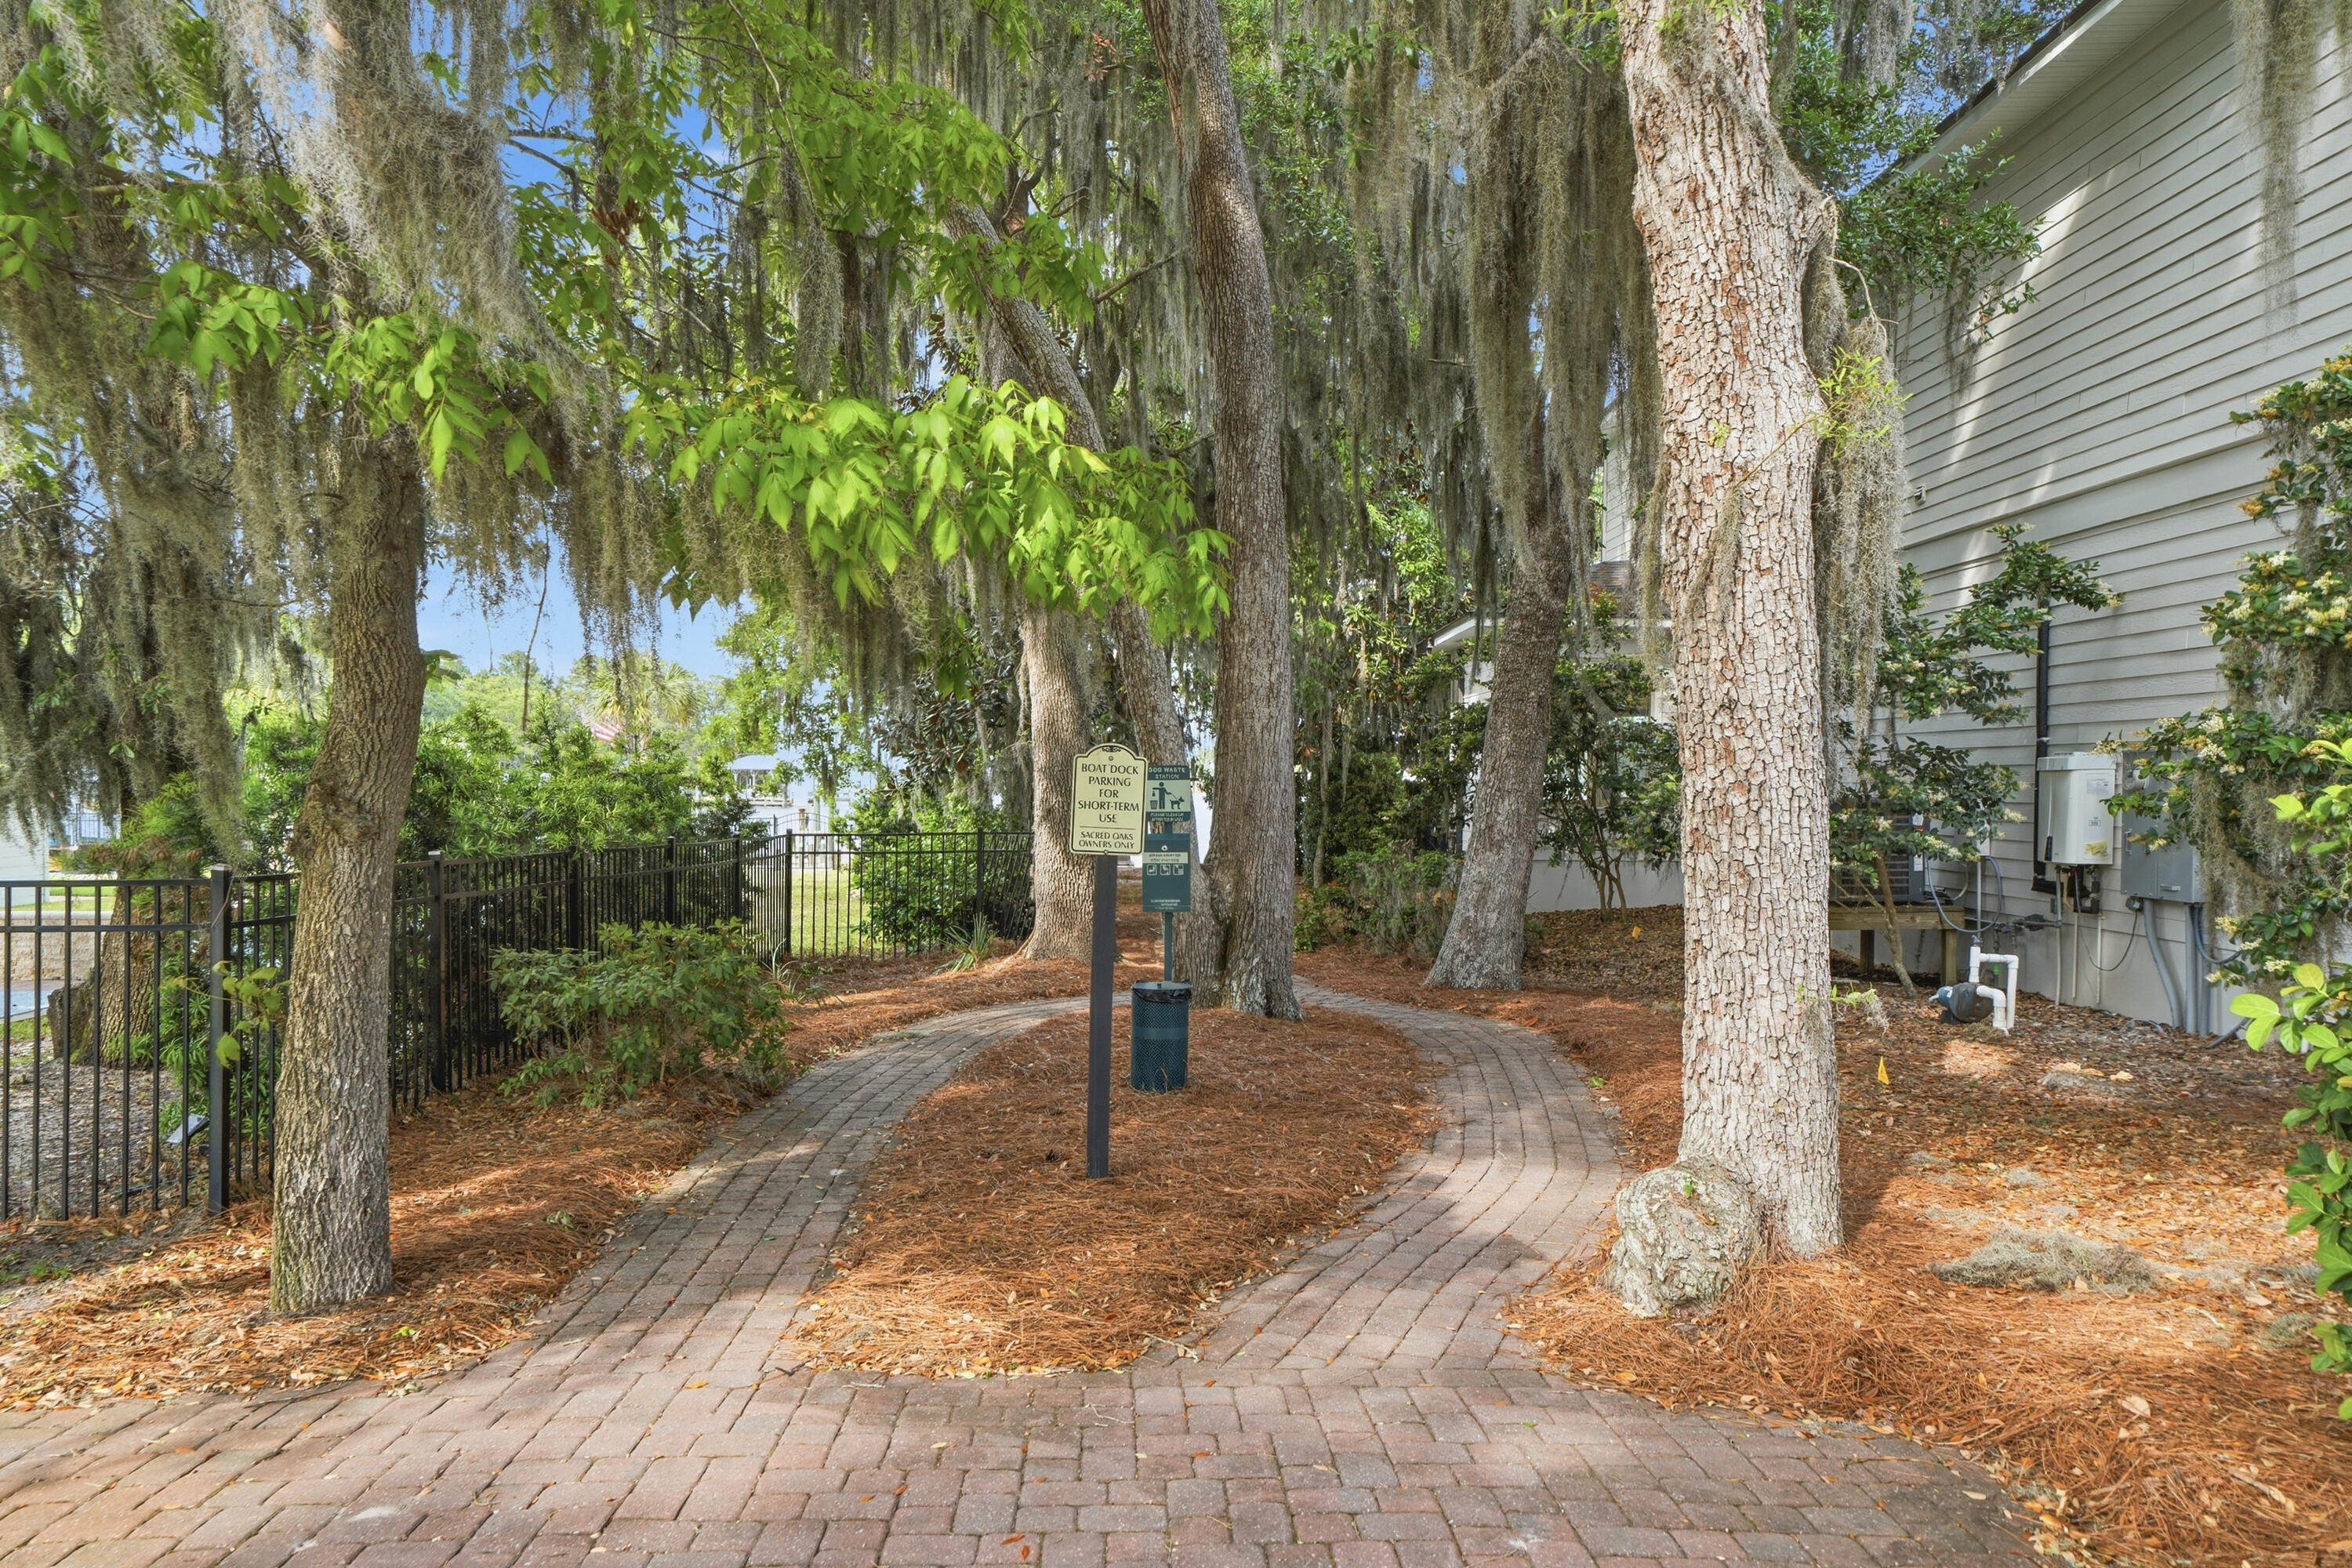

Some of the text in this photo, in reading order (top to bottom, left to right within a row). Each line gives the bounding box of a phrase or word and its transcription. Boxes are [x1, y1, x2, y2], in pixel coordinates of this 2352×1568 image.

[1081, 763, 1138, 775] BOAT DOCK
[1088, 776, 1131, 786] PARKING
[1099, 789, 1119, 798] FOR
[1078, 800, 1140, 811] SHORT-TERM
[1099, 814, 1117, 823] USE
[1080, 831, 1111, 840] SACRED
[1079, 840, 1135, 849] OWNERS ONLY
